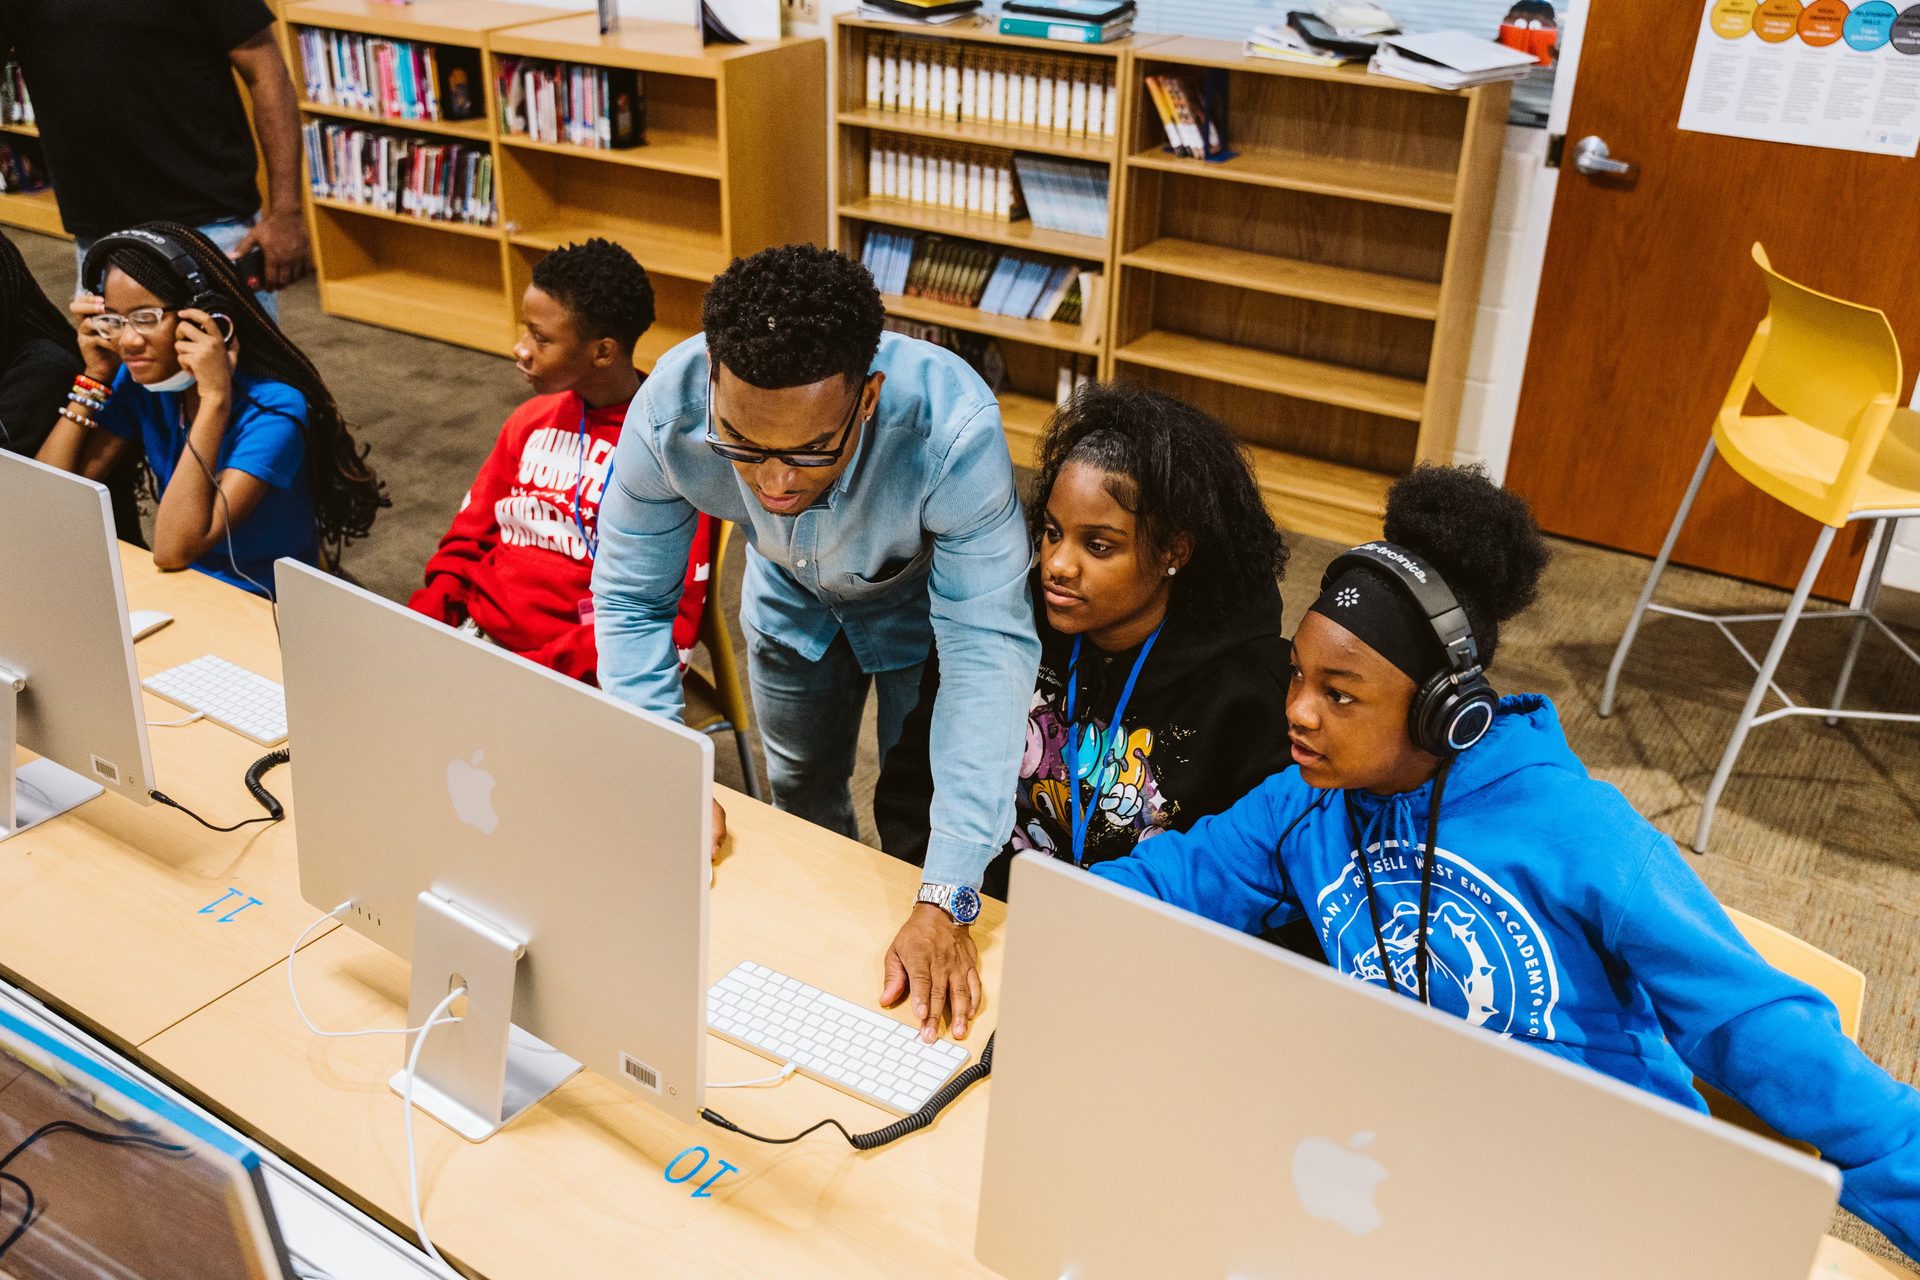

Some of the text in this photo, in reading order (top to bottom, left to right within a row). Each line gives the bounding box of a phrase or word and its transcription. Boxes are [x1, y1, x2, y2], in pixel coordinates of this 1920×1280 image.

[1341, 892, 1353, 906] J.
[1352, 855, 1408, 889] RSELL
[1415, 856, 1454, 881] WST
[1460, 876, 1492, 906] END
[1496, 910, 1545, 997] ACADEMY
[1528, 1011, 1539, 1037] 021
[663, 1145, 739, 1198] 10
